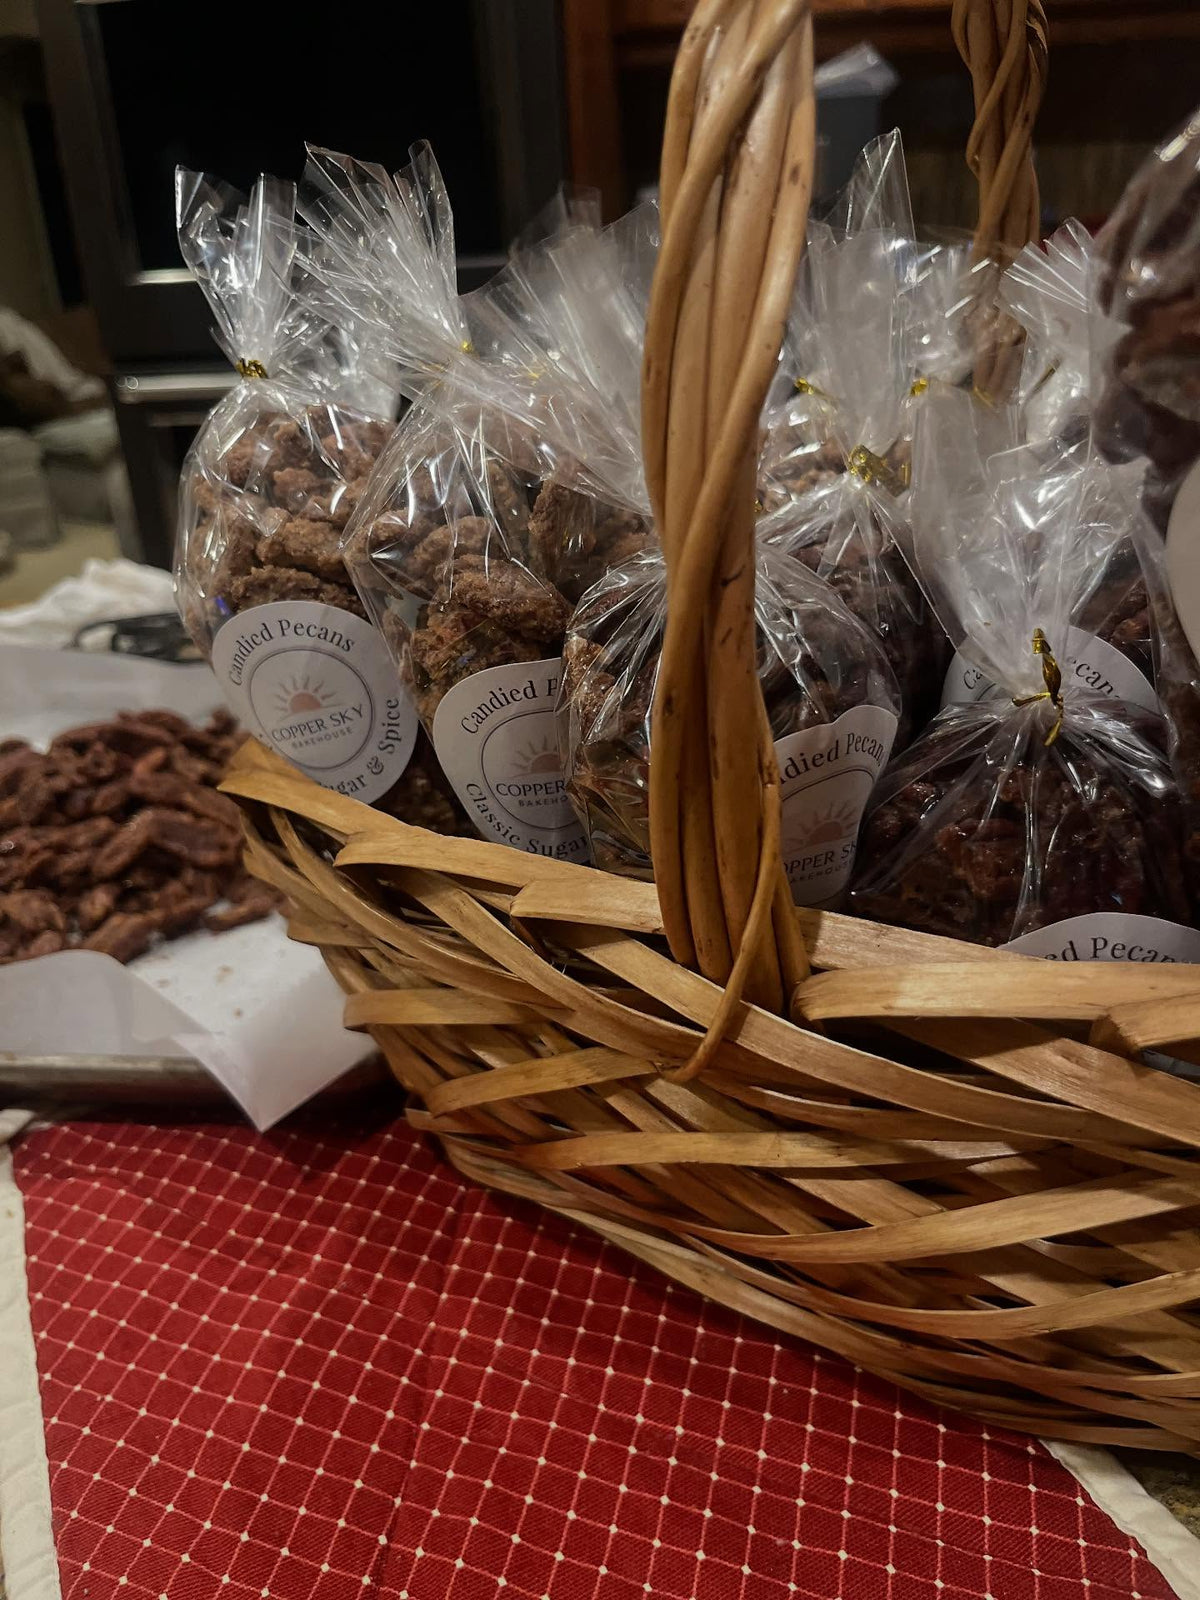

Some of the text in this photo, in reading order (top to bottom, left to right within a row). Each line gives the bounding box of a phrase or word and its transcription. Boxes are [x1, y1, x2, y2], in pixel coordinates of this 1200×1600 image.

[230, 619, 356, 687] Candied Pecans
[271, 719, 327, 744] COPPER
[329, 704, 364, 728] SKY
[460, 680, 539, 735] Candied
[366, 755, 385, 777] &
[379, 697, 403, 755] Spice
[779, 732, 885, 785] died Pecan
[465, 782, 521, 846] Classic
[495, 780, 567, 798] COPPER
[517, 794, 569, 808] BAKEHO
[784, 850, 835, 874] PPER
